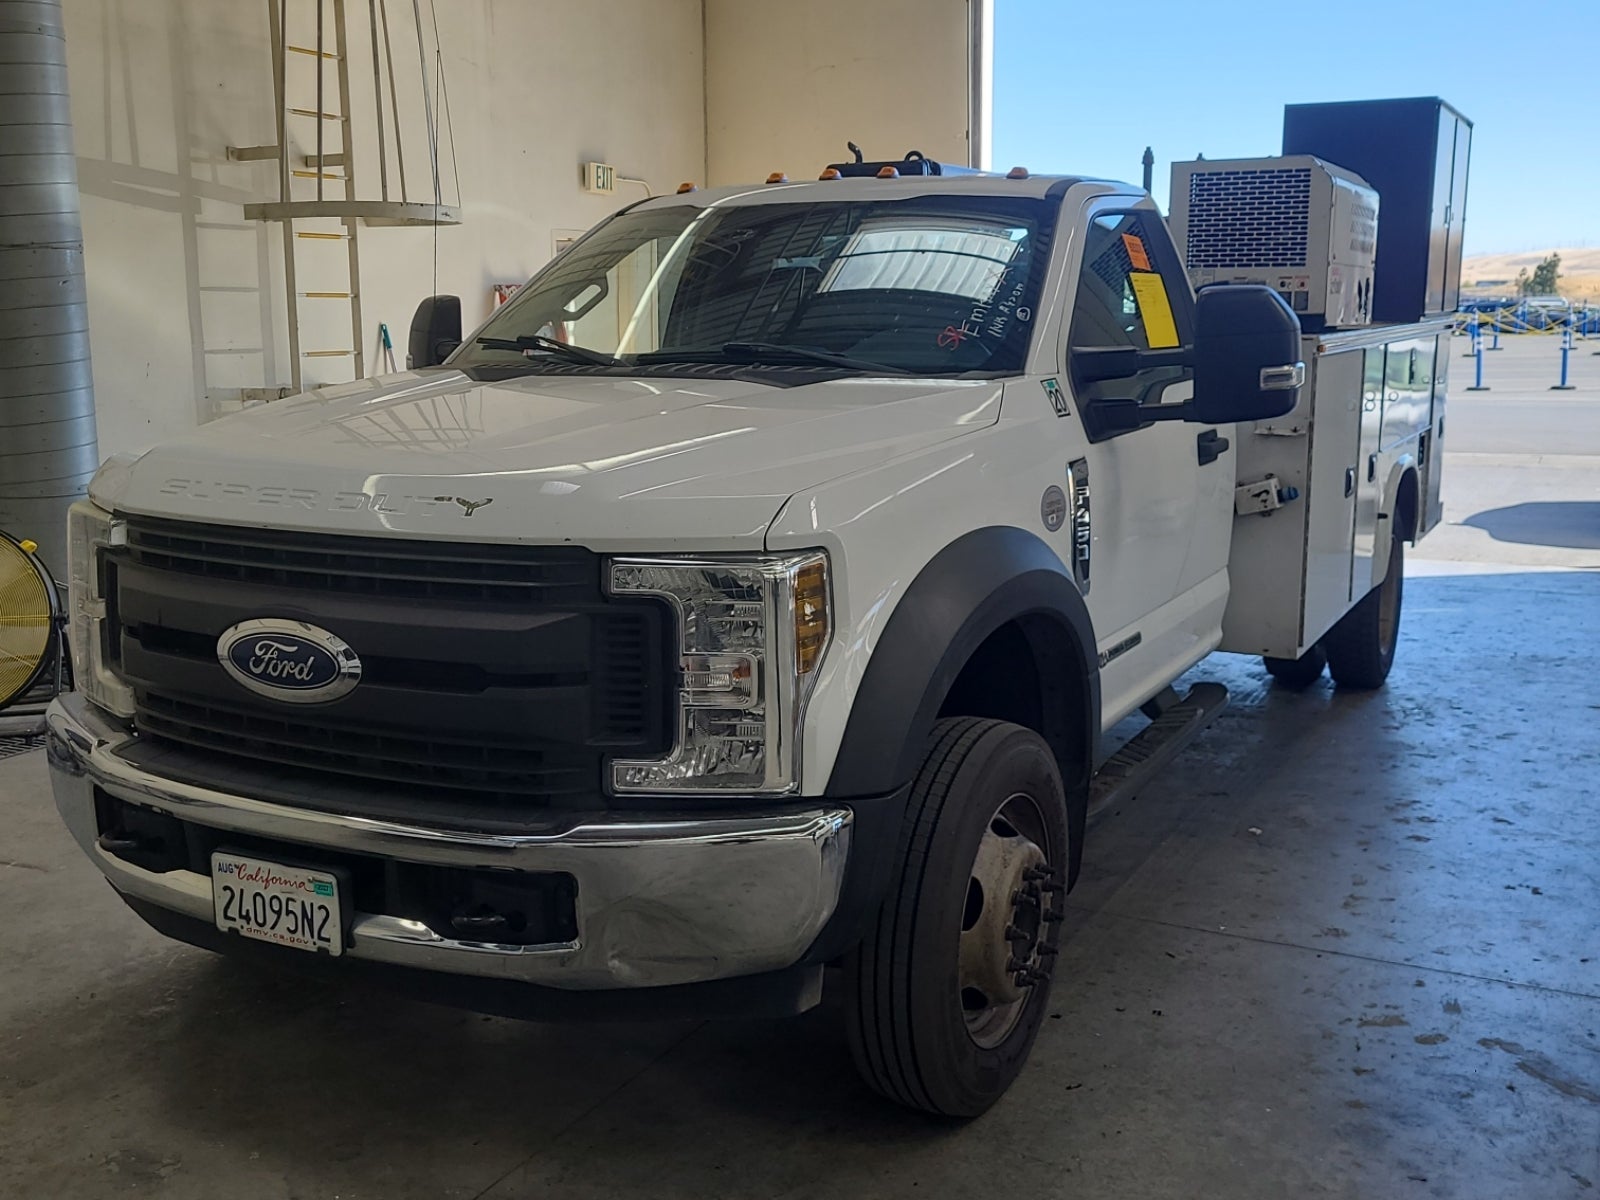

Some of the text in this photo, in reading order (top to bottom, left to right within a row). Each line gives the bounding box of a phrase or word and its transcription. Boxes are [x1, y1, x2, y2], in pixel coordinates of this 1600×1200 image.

[595, 164, 614, 191] EXIT
[160, 477, 494, 517] SUPER DUTY
[249, 640, 315, 681] Ford
[217, 861, 234, 874] AUG
[236, 862, 317, 893] California
[222, 884, 331, 943] 24095N2
